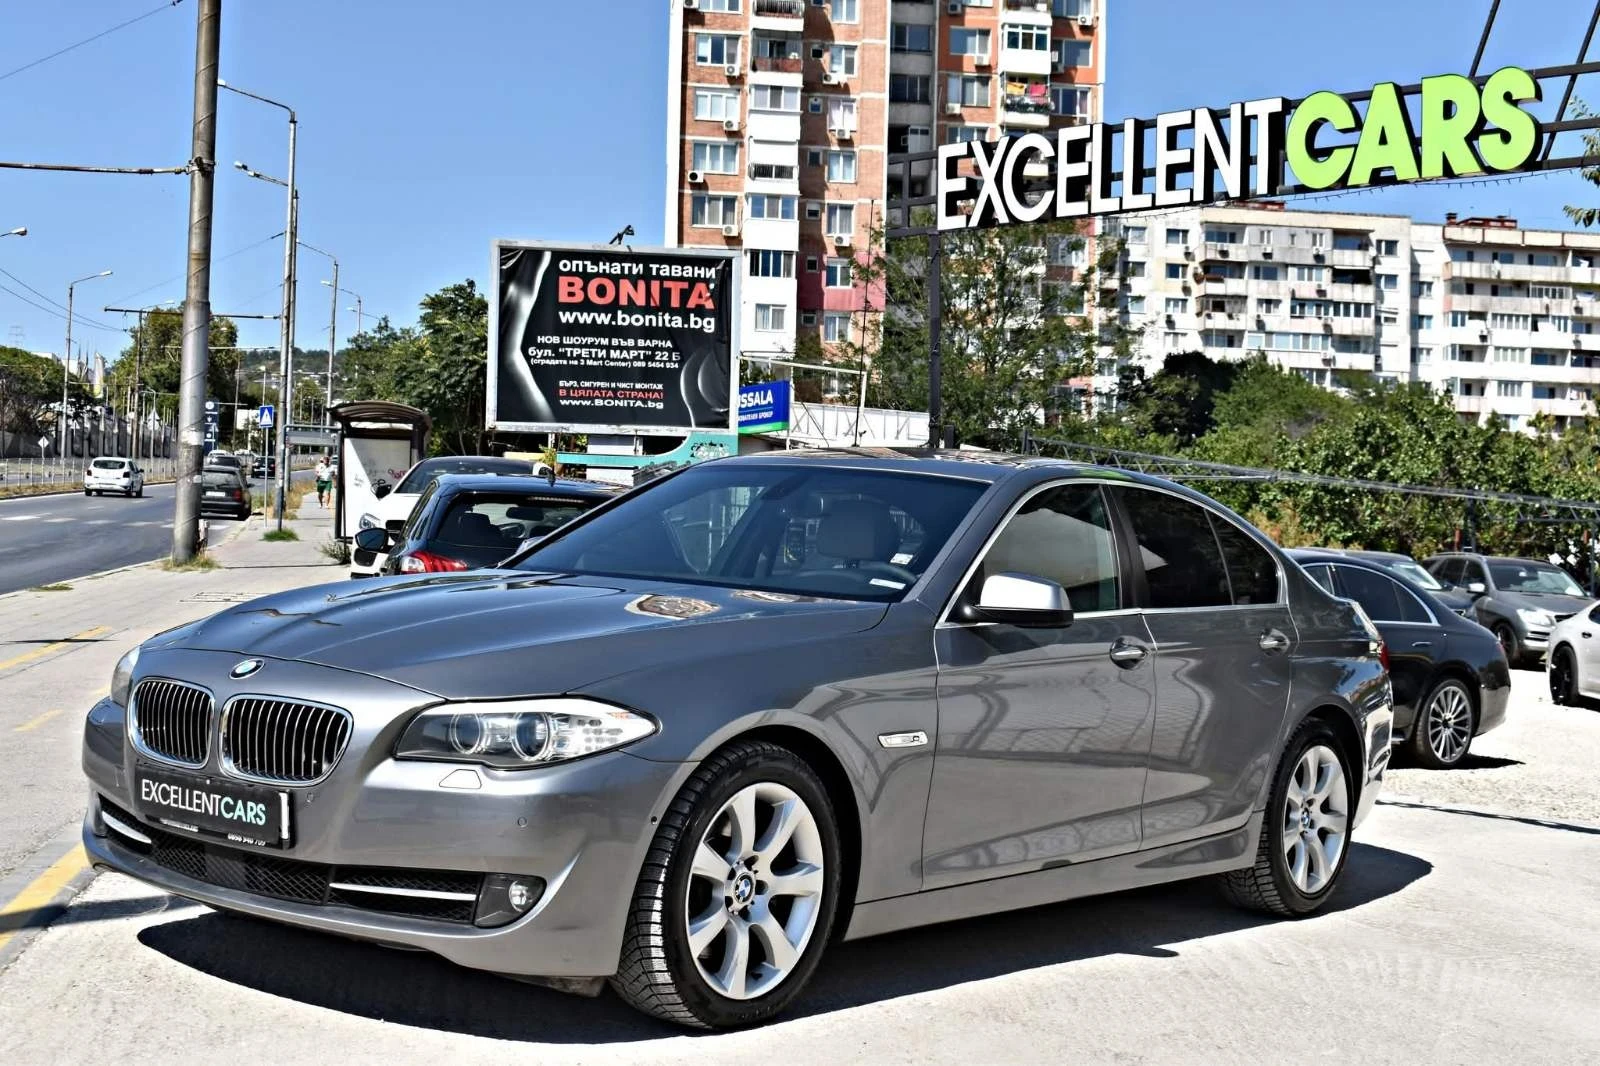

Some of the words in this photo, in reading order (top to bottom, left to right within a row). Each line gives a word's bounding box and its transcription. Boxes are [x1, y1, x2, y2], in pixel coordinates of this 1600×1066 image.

[558, 259, 644, 275] опънати
[649, 263, 716, 279] тавани
[558, 275, 715, 310] BONITA
[558, 310, 716, 333] www.bonita.bg
[537, 335, 560, 345] НОВ
[562, 336, 609, 346] ШОУРУМ
[611, 338, 635, 347] ВЪВ
[637, 339, 673, 348] ВАРНА
[528, 346, 555, 359] бул.
[654, 351, 669, 361] 22
[586, 359, 603, 367] Mart
[604, 361, 632, 369] Center)
[580, 381, 610, 389] СИГУРЕН
[569, 389, 614, 398] ЦЯЛАТА
[616, 391, 664, 399] СТРАНА!
[559, 399, 664, 409] www.BONITA.bg
